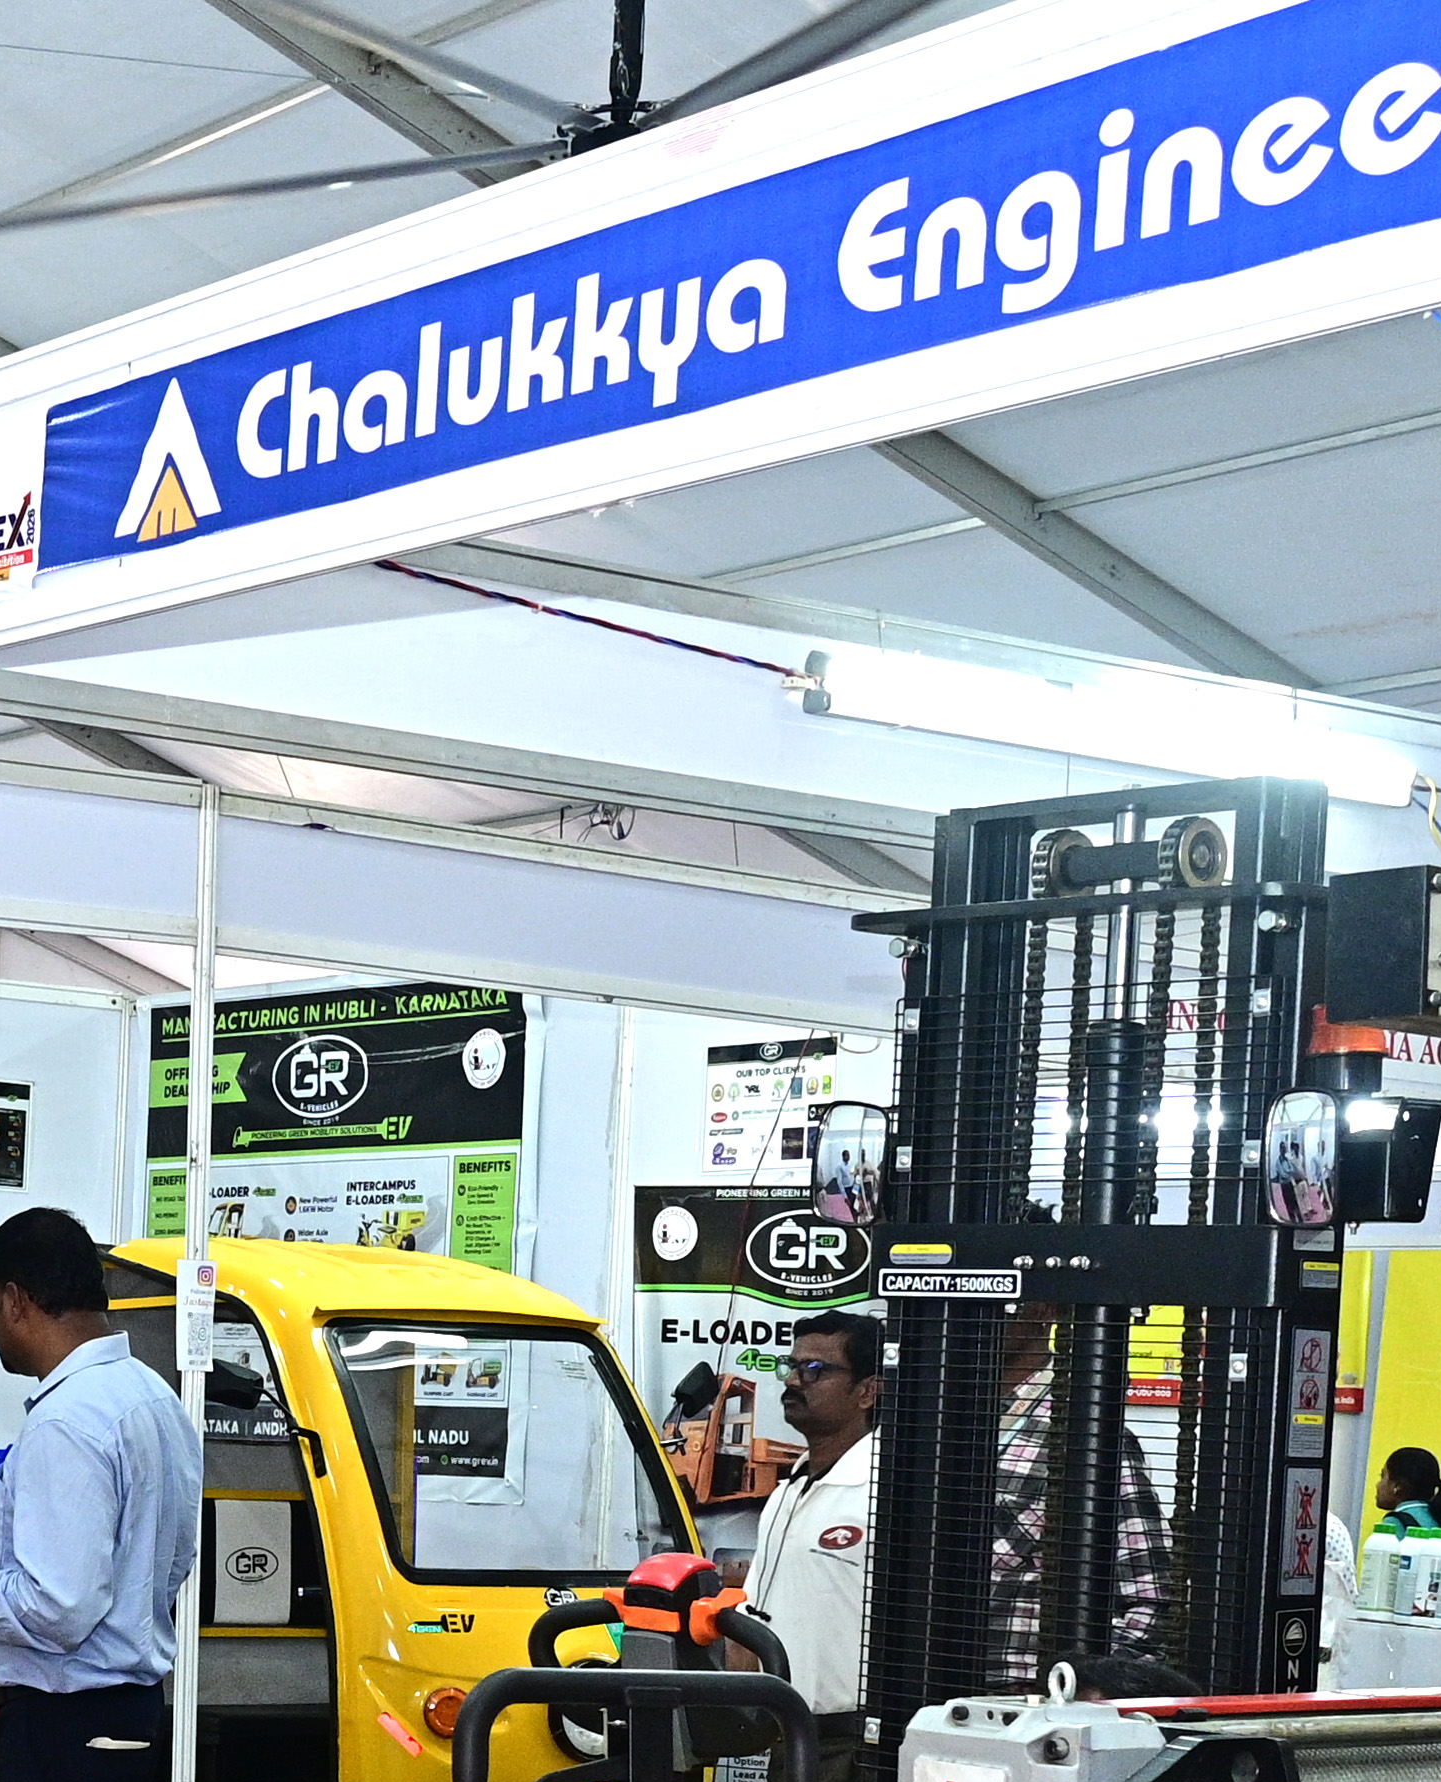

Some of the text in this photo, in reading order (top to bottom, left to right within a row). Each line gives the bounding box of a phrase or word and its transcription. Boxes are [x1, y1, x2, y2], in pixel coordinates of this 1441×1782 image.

[236, 258, 788, 480] Chalukkya
[162, 988, 508, 1036] MANACTURING IN HUBLI KARNATAKA
[290, 1048, 350, 1098] GR
[736, 1065, 806, 1078] OUR TOP CLIENTS
[251, 1125, 377, 1139] PIONEERING GREEN MOBILITY SOLUTIONS
[387, 1115, 413, 1140] EV
[459, 1161, 511, 1174] BENEFITS
[153, 1174, 186, 1186] BENEFIT
[347, 1180, 416, 1192] INTERCAMPUS
[209, 1187, 249, 1198] -LOADER
[346, 1194, 395, 1205] E-LOADER
[716, 1188, 768, 1198] PIONEERING
[770, 1188, 801, 1198] GREEN
[769, 1222, 847, 1270] GR
[780, 1272, 832, 1282] E-VEHICLES
[886, 1275, 1013, 1292] CAPACITY:1500KGS
[811, 1287, 833, 1296] 2019
[661, 1318, 793, 1346] E-LOADE
[203, 1420, 239, 1433] ATAKA
[429, 1430, 469, 1445] NADU
[235, 1552, 268, 1574] GR
[448, 1613, 475, 1634] EV
